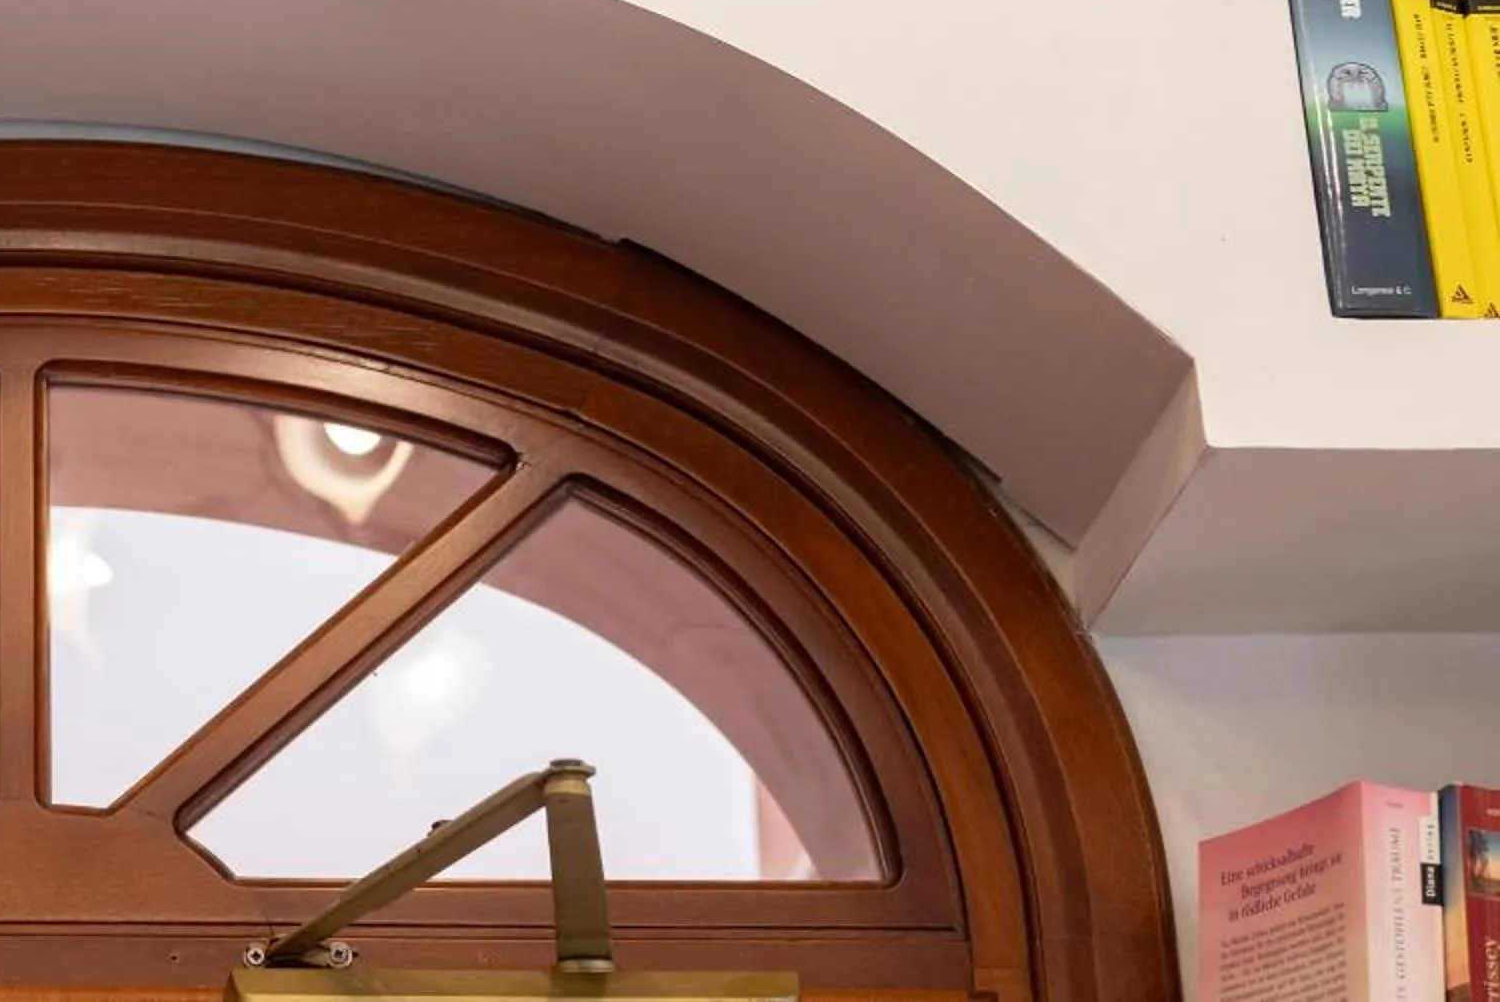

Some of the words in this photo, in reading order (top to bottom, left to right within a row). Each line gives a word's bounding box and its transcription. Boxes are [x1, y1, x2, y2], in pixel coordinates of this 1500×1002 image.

[1360, 117, 1378, 131] IL
[1343, 128, 1362, 153] DEI
[1362, 134, 1391, 217] SERPENTE
[1221, 870, 1244, 886] Eine
[1241, 869, 1297, 899] Begegnung
[1299, 858, 1328, 880] bringt
[1424, 866, 1436, 898] Diana
[1229, 909, 1240, 922] in
[1283, 881, 1317, 904] Gefahr
